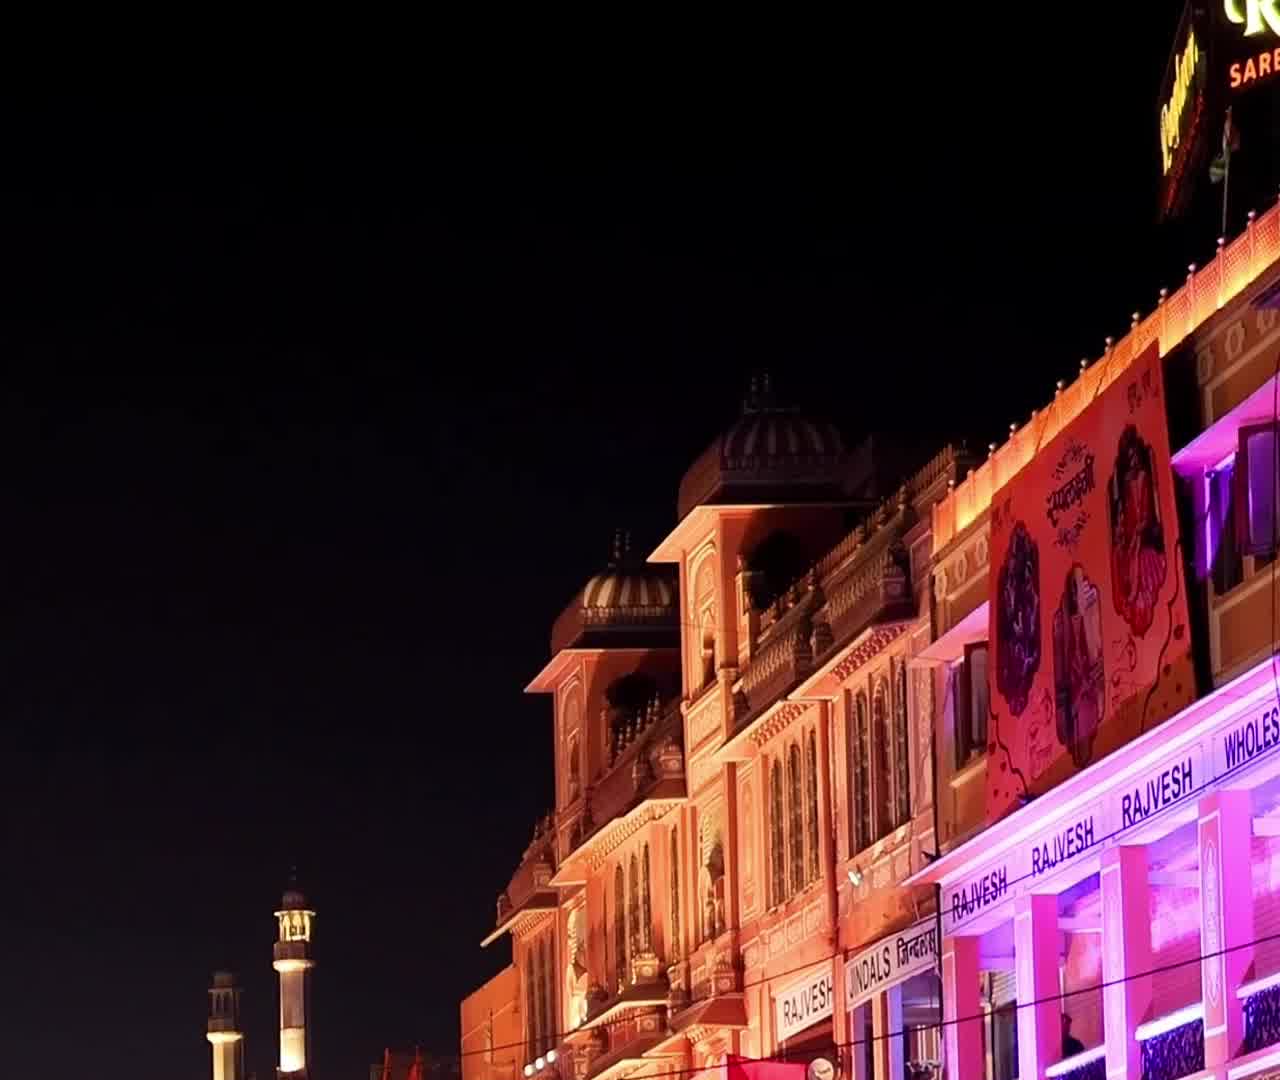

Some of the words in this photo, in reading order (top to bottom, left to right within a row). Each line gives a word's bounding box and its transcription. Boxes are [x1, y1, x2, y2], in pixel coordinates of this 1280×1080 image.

[1224, 707, 1280, 769] WHOLES
[1122, 756, 1193, 829] RAJVESH
[1032, 815, 1096, 877] RAJVESH
[952, 865, 1008, 923] RAJVESH
[784, 978, 833, 1029] RAJVESH
